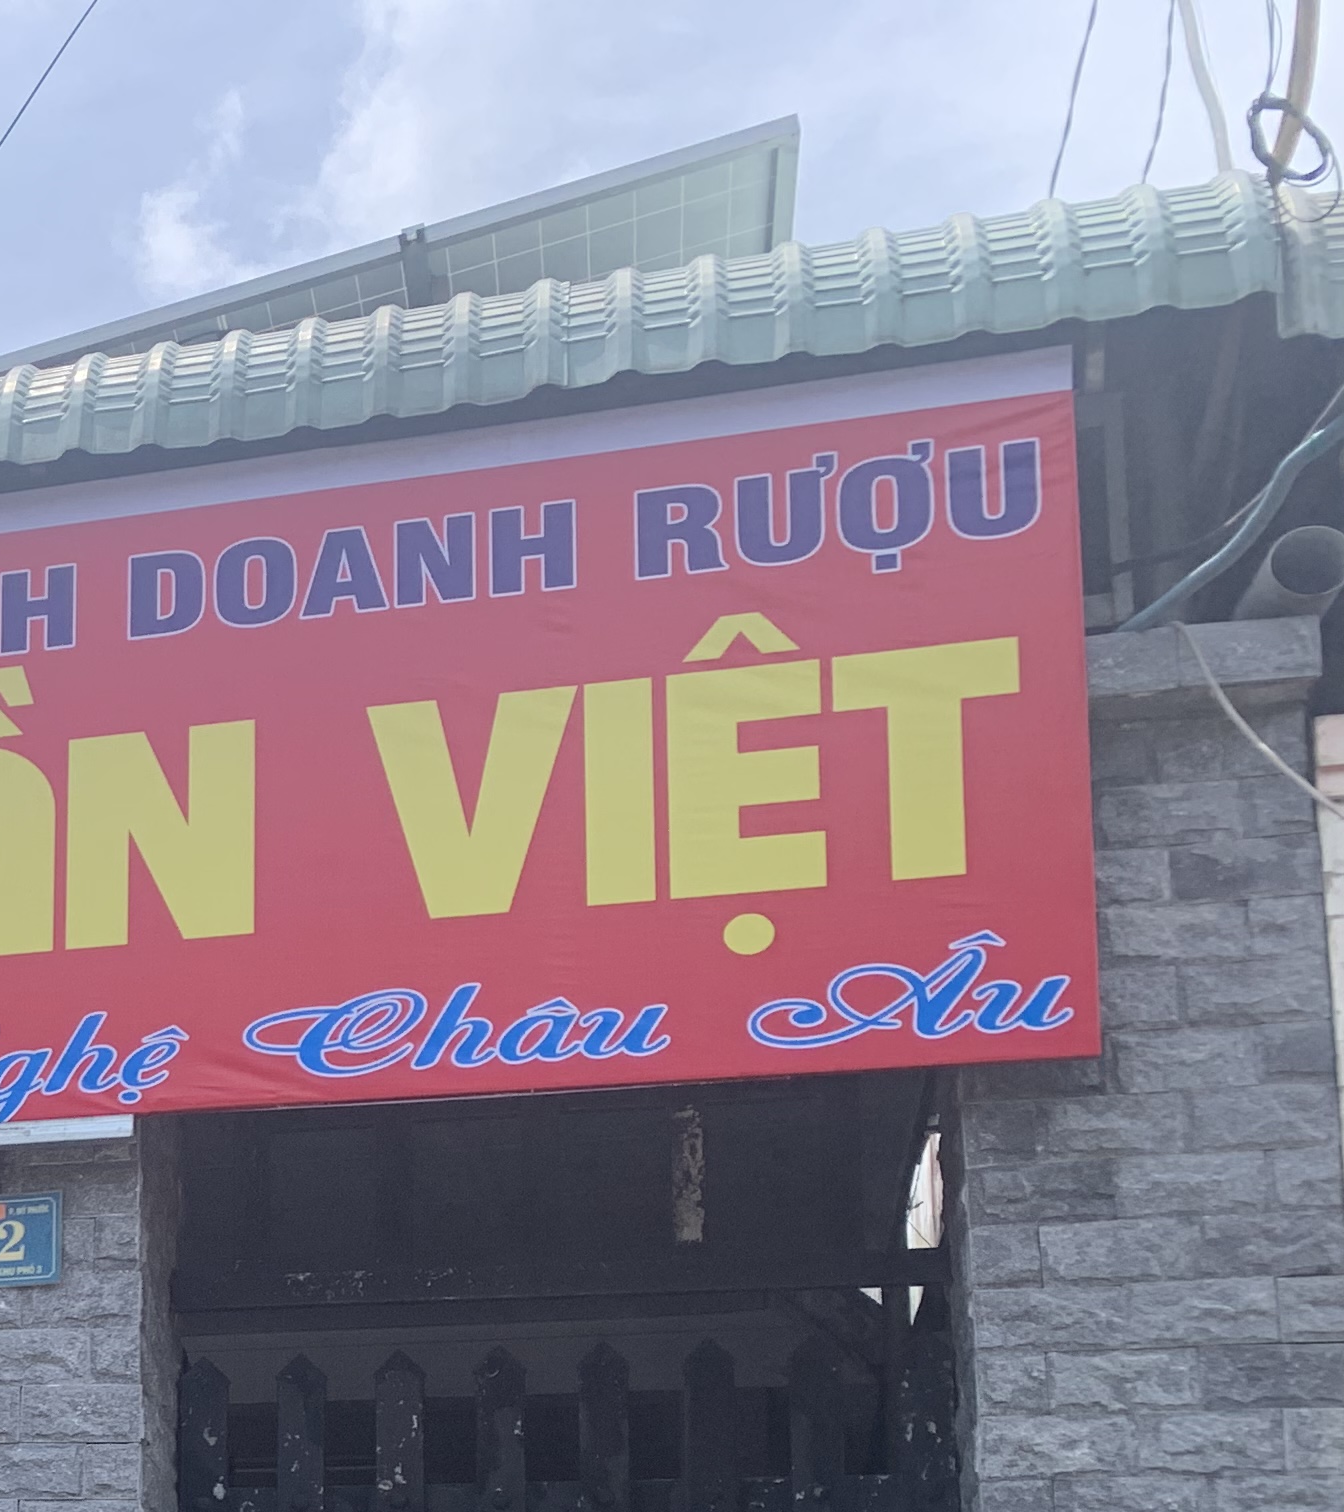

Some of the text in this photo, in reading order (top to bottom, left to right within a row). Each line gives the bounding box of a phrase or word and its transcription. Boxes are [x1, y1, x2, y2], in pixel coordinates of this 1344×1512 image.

[127, 497, 579, 642] DOANH
[633, 437, 1042, 580] RƯỢU
[365, 611, 1021, 957] VIỆT
[242, 982, 670, 1078] Châu
[747, 929, 1074, 1050] Âu
